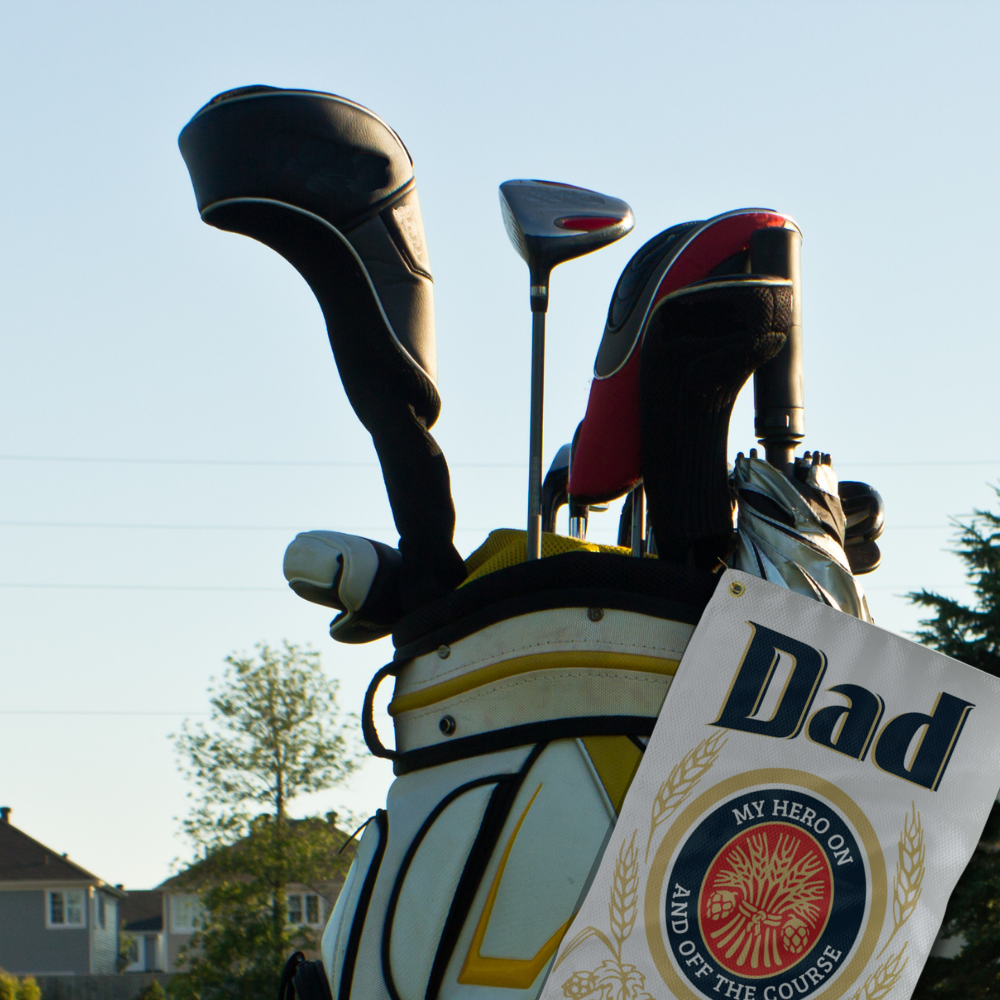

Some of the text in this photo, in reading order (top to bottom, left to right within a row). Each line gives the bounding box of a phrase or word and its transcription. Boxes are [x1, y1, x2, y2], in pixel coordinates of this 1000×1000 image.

[706, 620, 976, 792] Dad
[731, 799, 854, 866] MY HERO ON
[671, 882, 691, 935] AND
[678, 940, 714, 979] OFF
